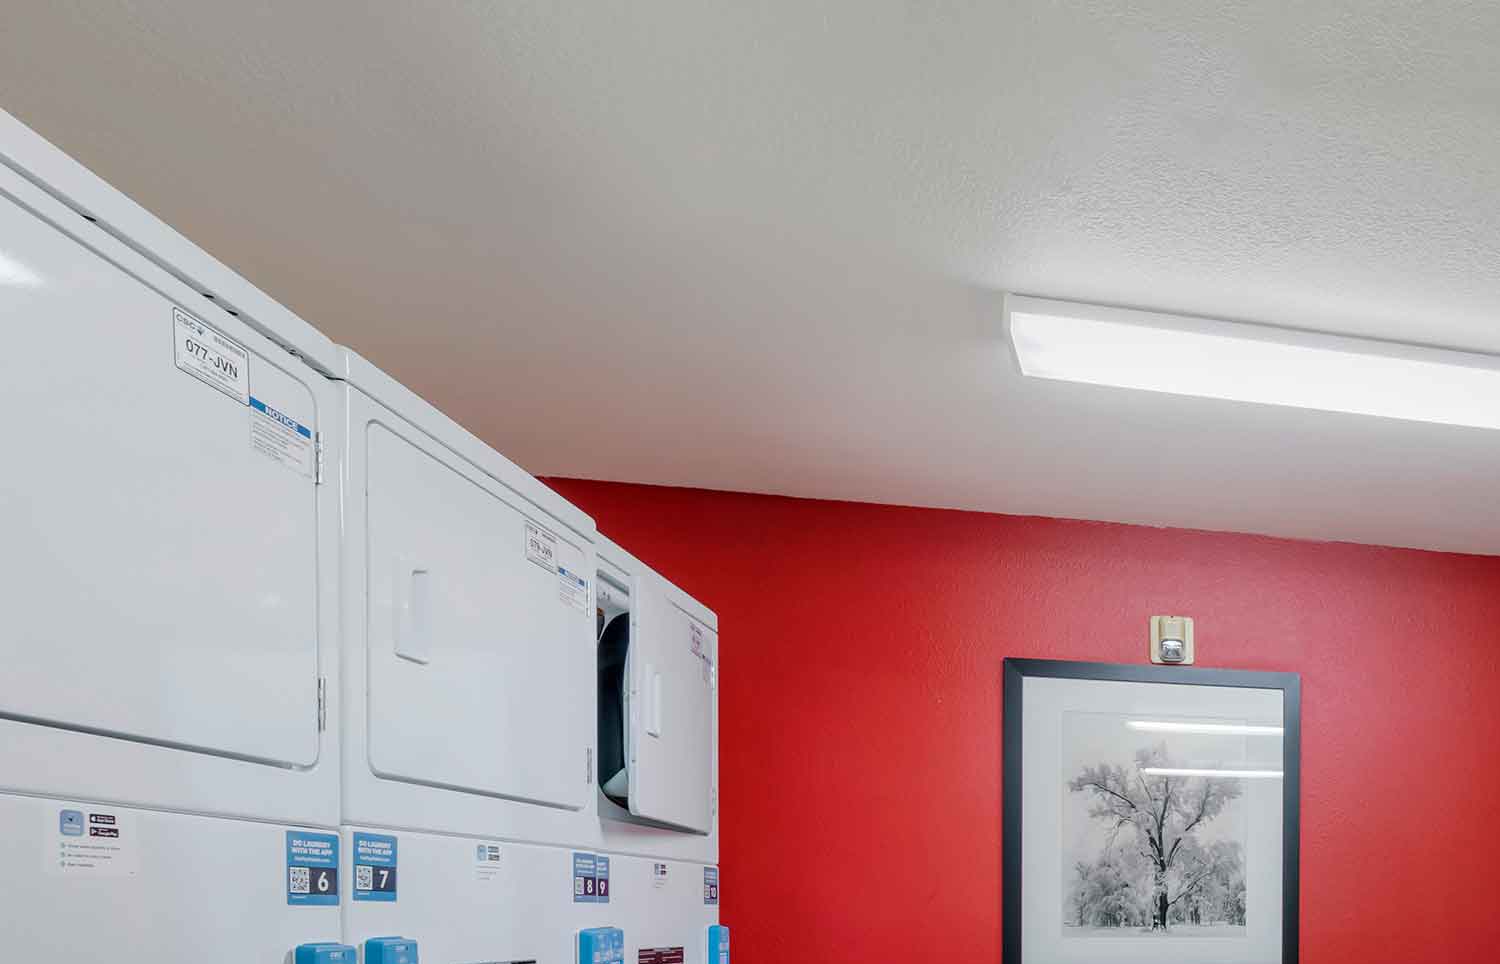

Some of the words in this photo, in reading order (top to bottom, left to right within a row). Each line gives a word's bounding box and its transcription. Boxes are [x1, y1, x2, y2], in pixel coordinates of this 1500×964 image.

[186, 339, 238, 378] 077-JVN
[265, 407, 299, 431] NOTICE
[318, 872, 328, 891] 6
[379, 870, 389, 888] 7
[586, 879, 593, 894] 8
[600, 880, 606, 895] 9
